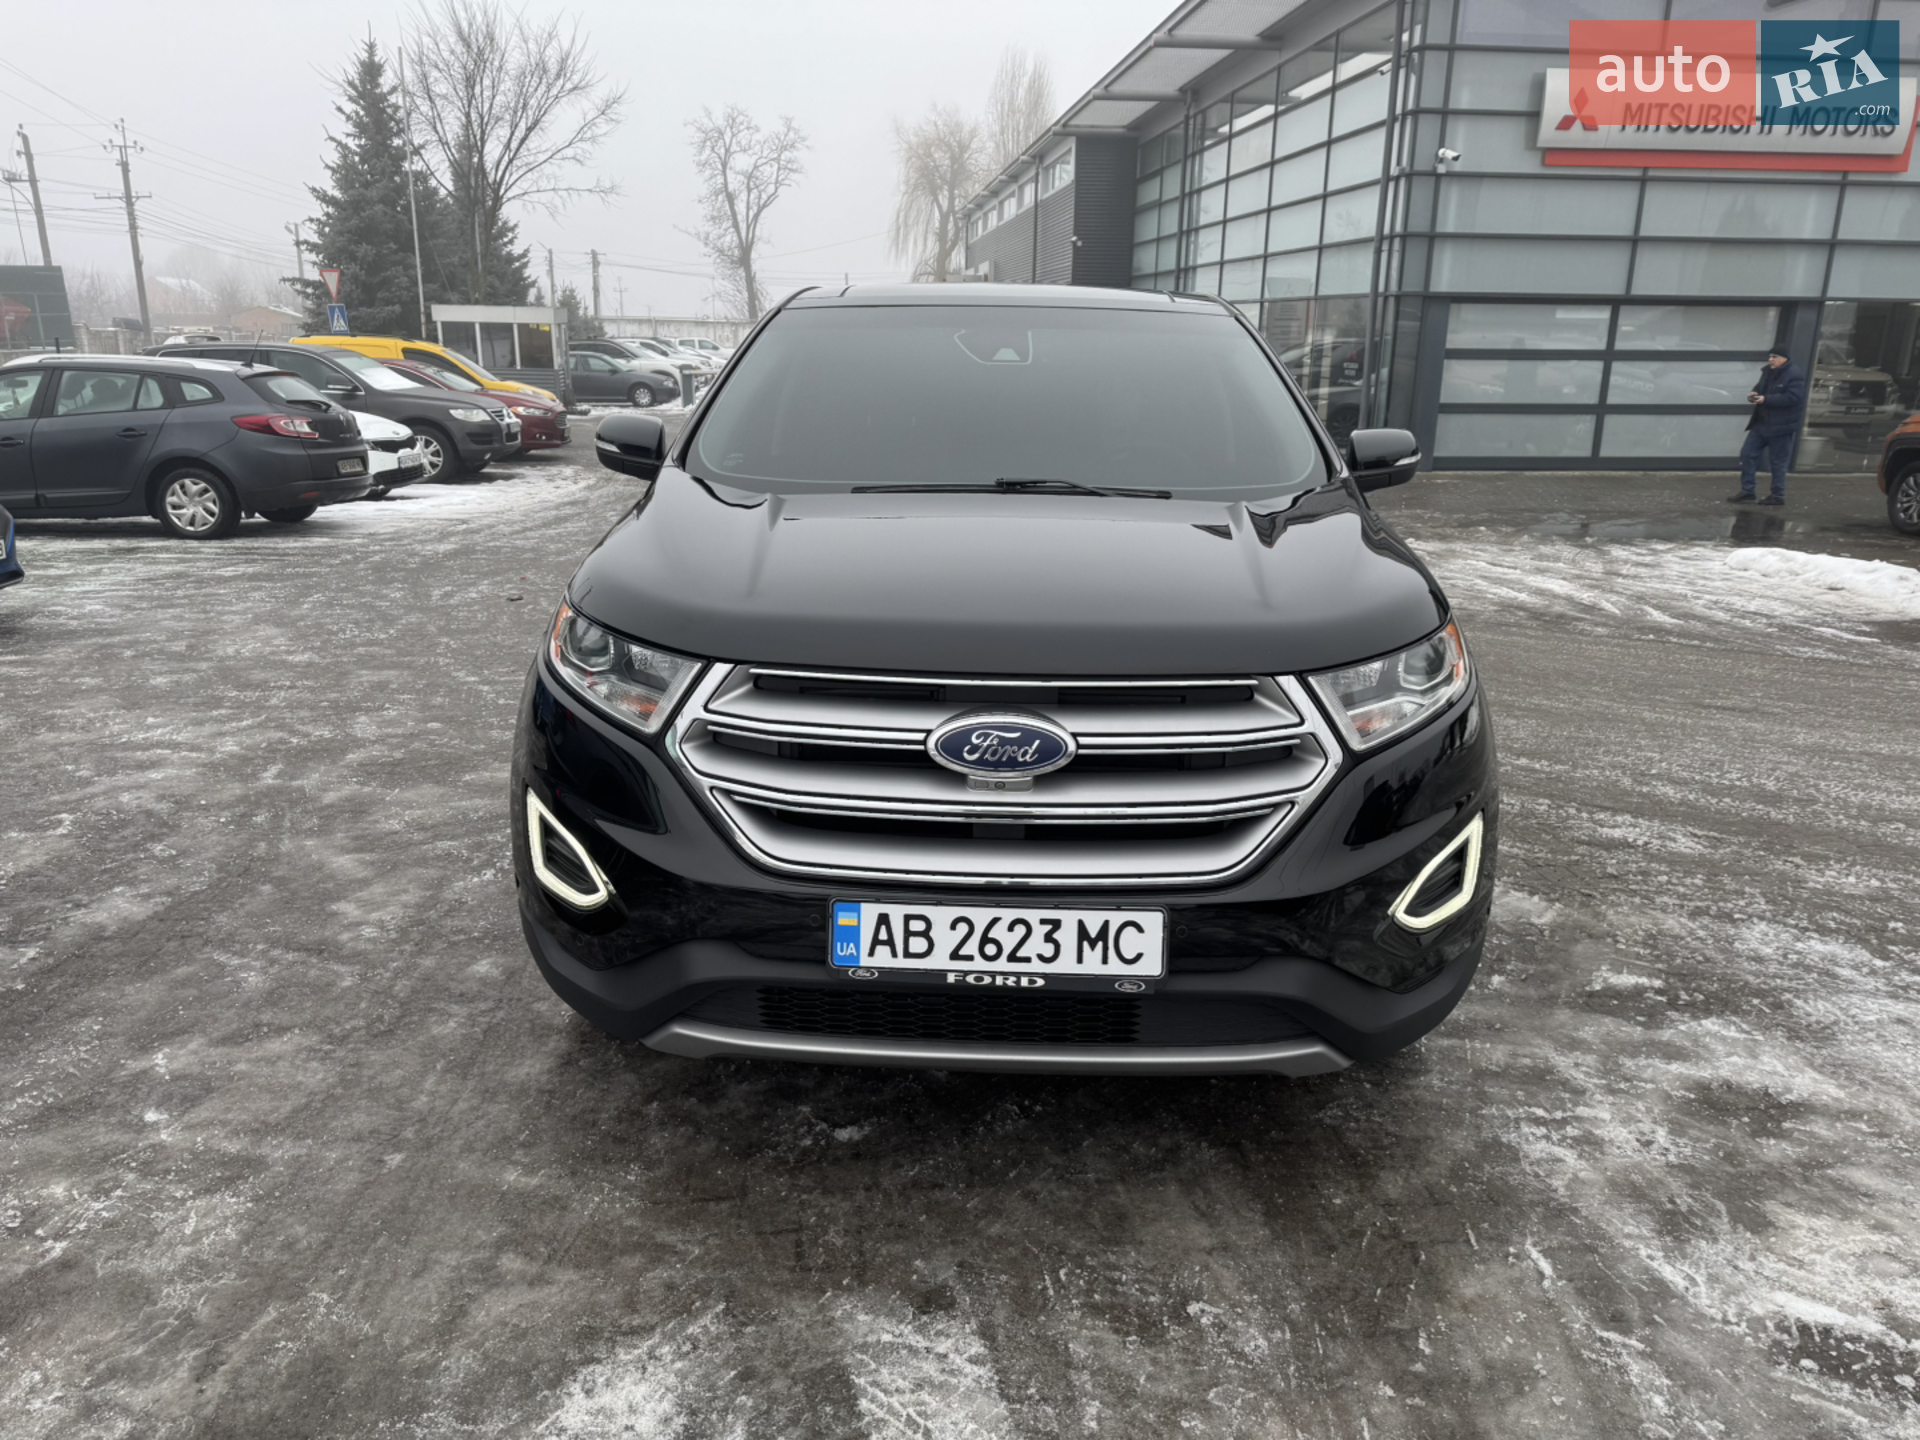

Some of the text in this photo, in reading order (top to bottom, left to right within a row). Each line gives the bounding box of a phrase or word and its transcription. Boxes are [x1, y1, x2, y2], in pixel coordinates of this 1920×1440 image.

[1619, 102, 1899, 138] MITSUBISHI MOTORS
[962, 729, 1041, 763] Ford
[836, 942, 858, 957] UA
[867, 912, 1146, 966] AB 2623 MC
[946, 972, 1046, 988] FORD
